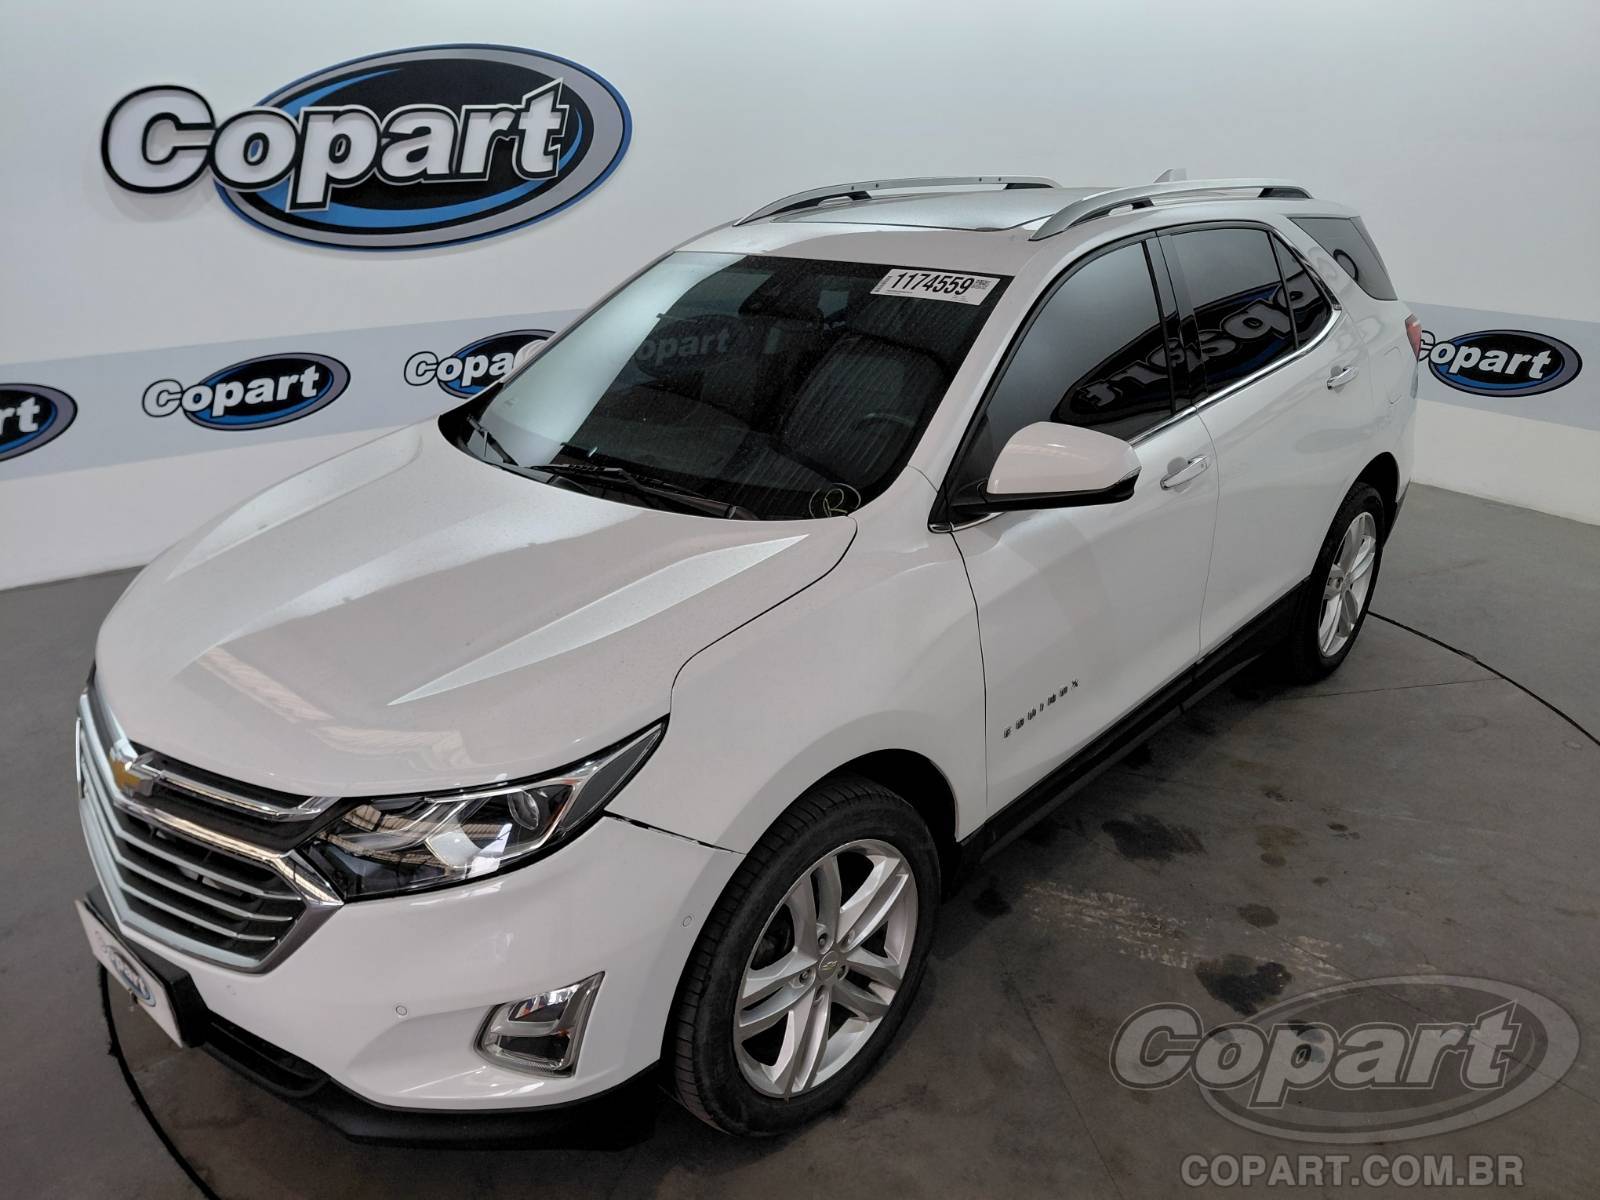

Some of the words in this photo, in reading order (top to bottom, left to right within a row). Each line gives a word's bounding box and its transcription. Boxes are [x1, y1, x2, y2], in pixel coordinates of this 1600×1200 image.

[102, 78, 569, 211] Copart
[891, 271, 975, 296] 1174559
[142, 364, 320, 418] Copart
[404, 351, 514, 387] Copa
